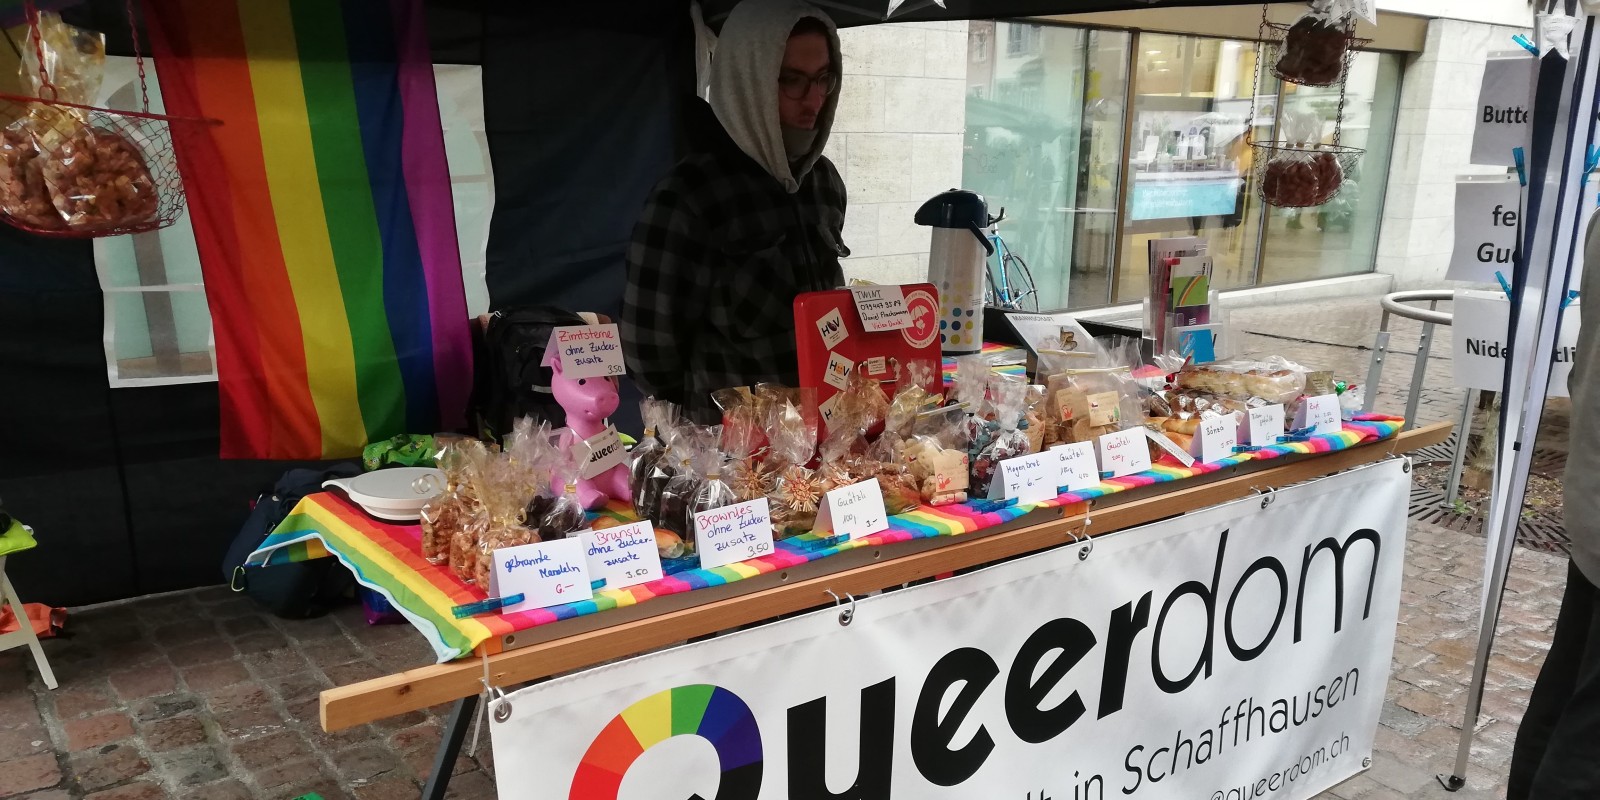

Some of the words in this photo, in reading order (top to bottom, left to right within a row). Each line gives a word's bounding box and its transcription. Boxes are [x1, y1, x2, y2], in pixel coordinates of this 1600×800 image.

[1477, 242, 1517, 264] Gu
[855, 289, 881, 300] TWINT
[558, 328, 614, 342] Zimtsterne
[565, 345, 585, 356] ohne
[574, 355, 603, 366] zusatz
[696, 505, 753, 530] Brownies
[594, 525, 642, 546] Brunsli
[707, 524, 733, 539] ohne
[588, 542, 614, 556] ohne
[714, 531, 757, 552] zusatz
[504, 550, 552, 573] gebrannte
[604, 551, 640, 566] zusatz
[539, 562, 581, 579] Mandeln
[568, 528, 1381, 800] Queerdom
[1121, 666, 1360, 795] Schaffhausen
